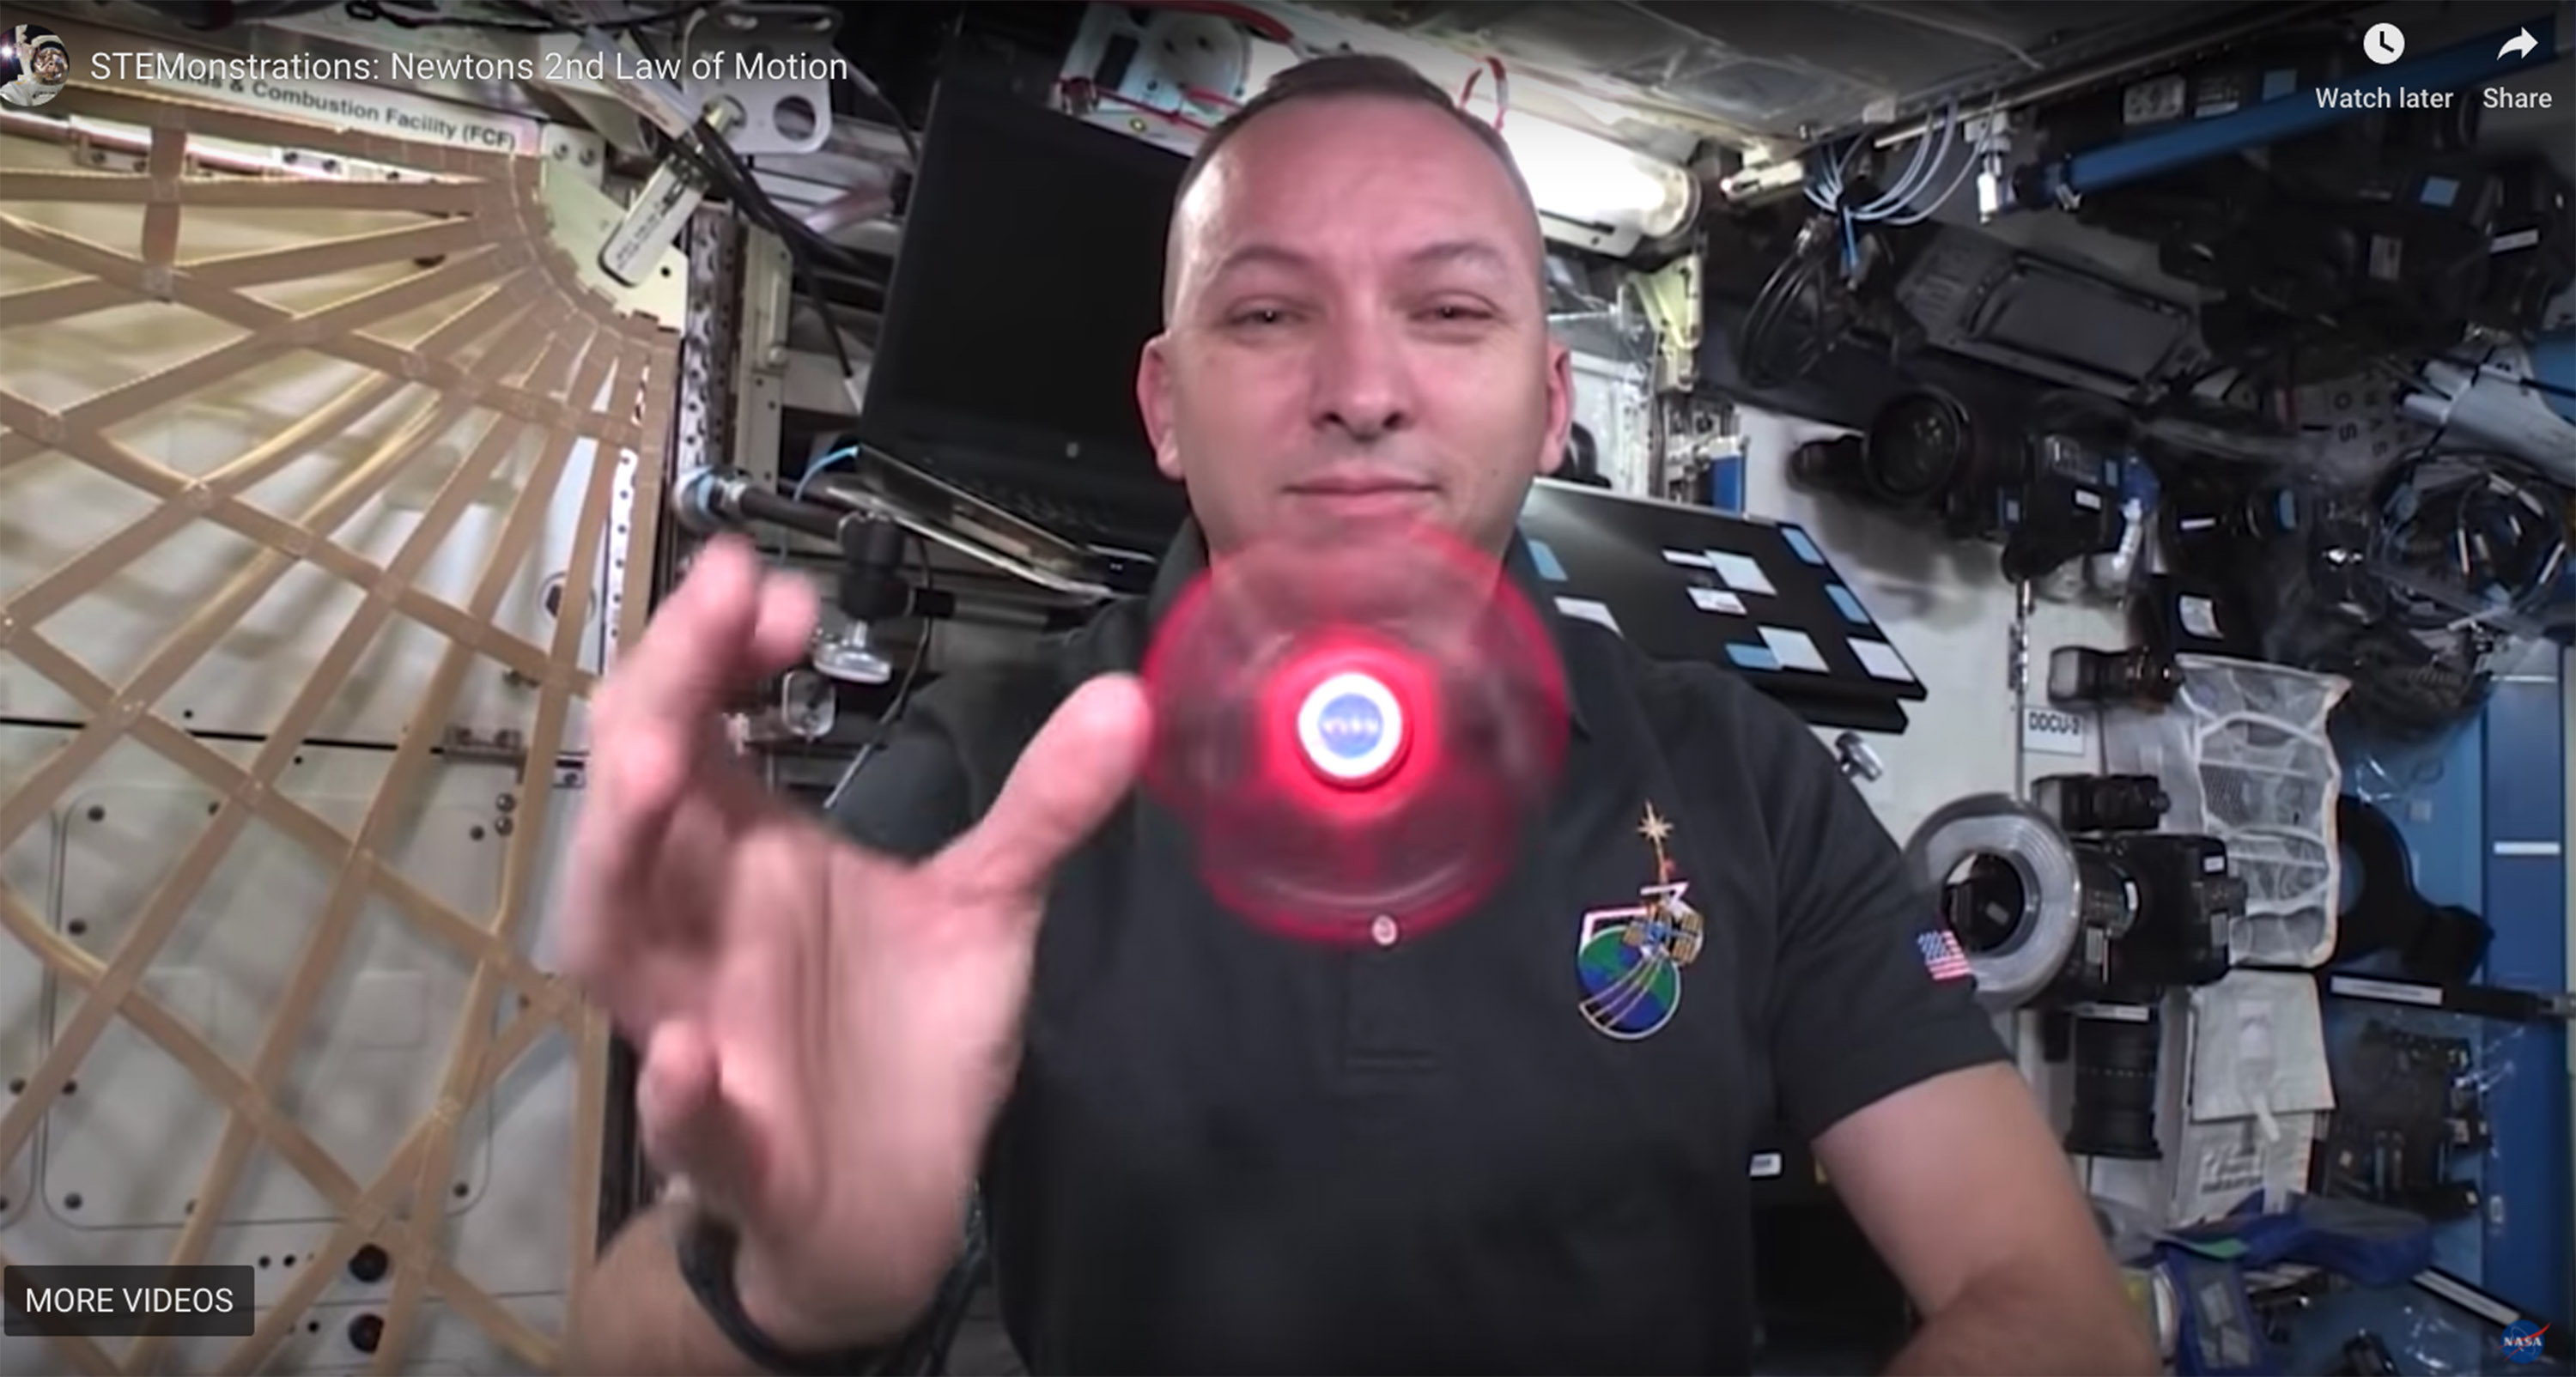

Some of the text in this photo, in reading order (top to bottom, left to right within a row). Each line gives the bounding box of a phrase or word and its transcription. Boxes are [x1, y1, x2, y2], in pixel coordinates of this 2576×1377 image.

[252, 80, 380, 121] Combustion
[386, 107, 459, 140] Facility
[462, 124, 516, 151] (FCF)
